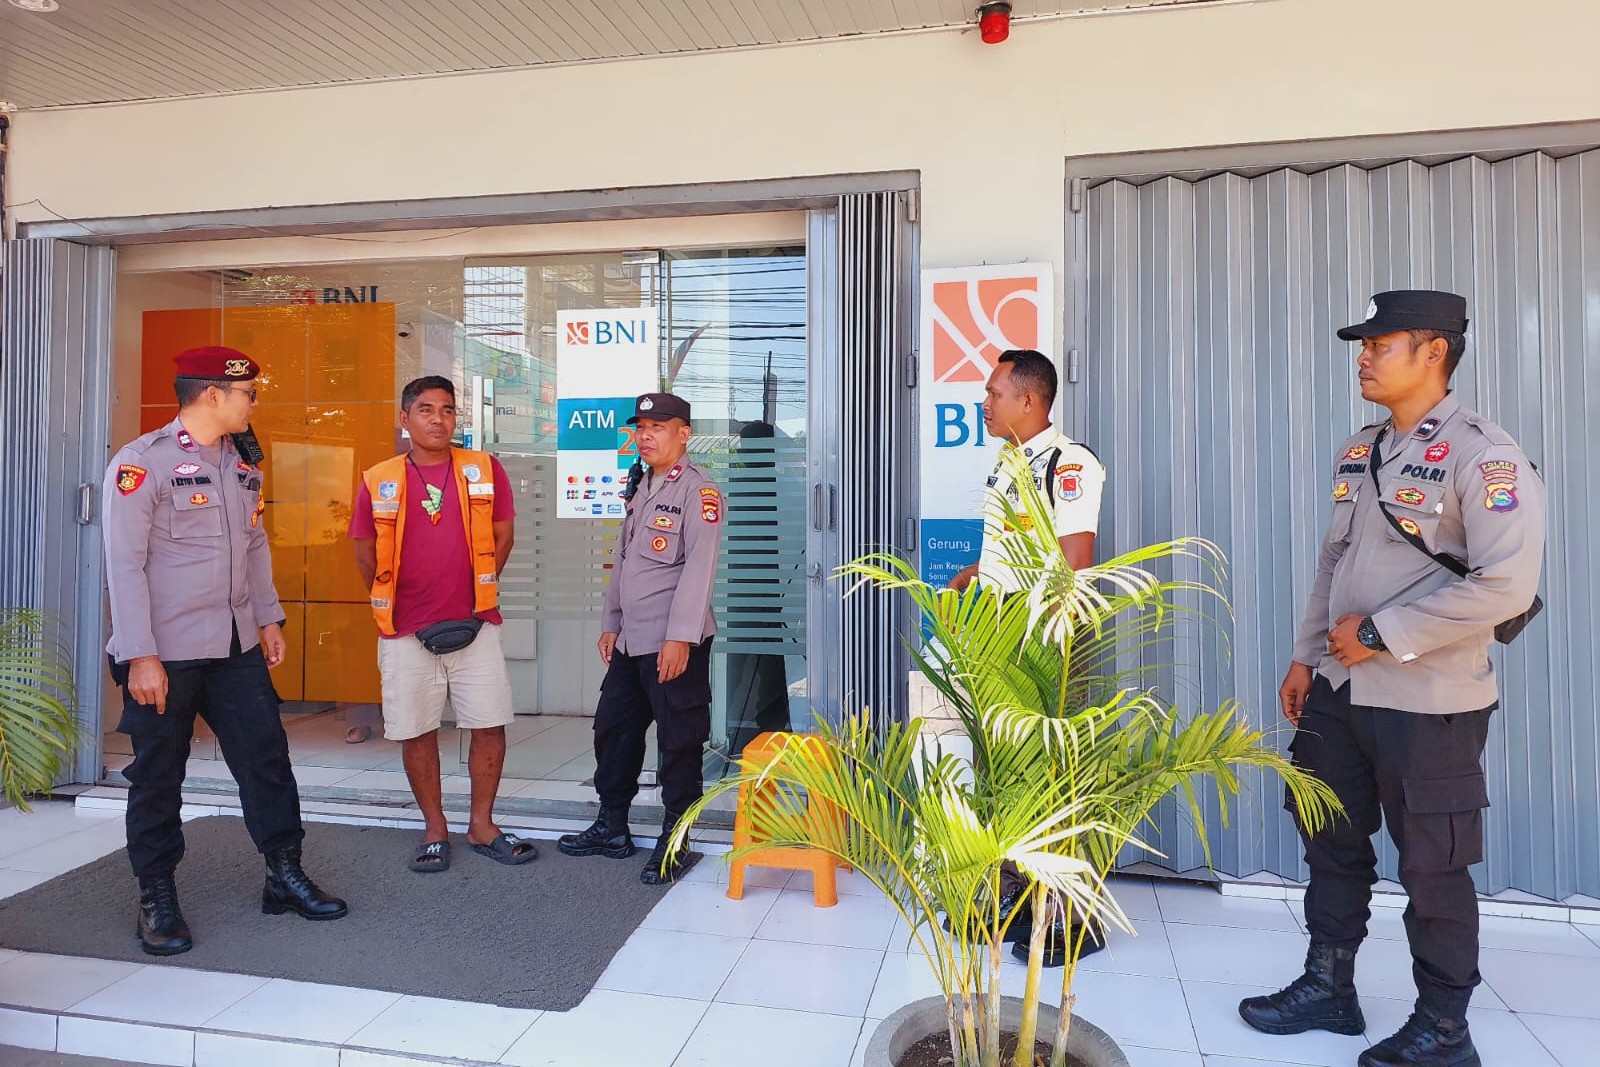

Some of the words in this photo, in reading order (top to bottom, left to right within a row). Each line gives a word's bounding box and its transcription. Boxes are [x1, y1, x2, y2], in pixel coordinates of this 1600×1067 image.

[595, 319, 647, 345] BNI
[568, 409, 615, 430] ATM
[1400, 463, 1446, 482] POLRI
[655, 503, 682, 516] POLRI
[927, 537, 971, 552] Gerung
[928, 561, 944, 570] Jam
